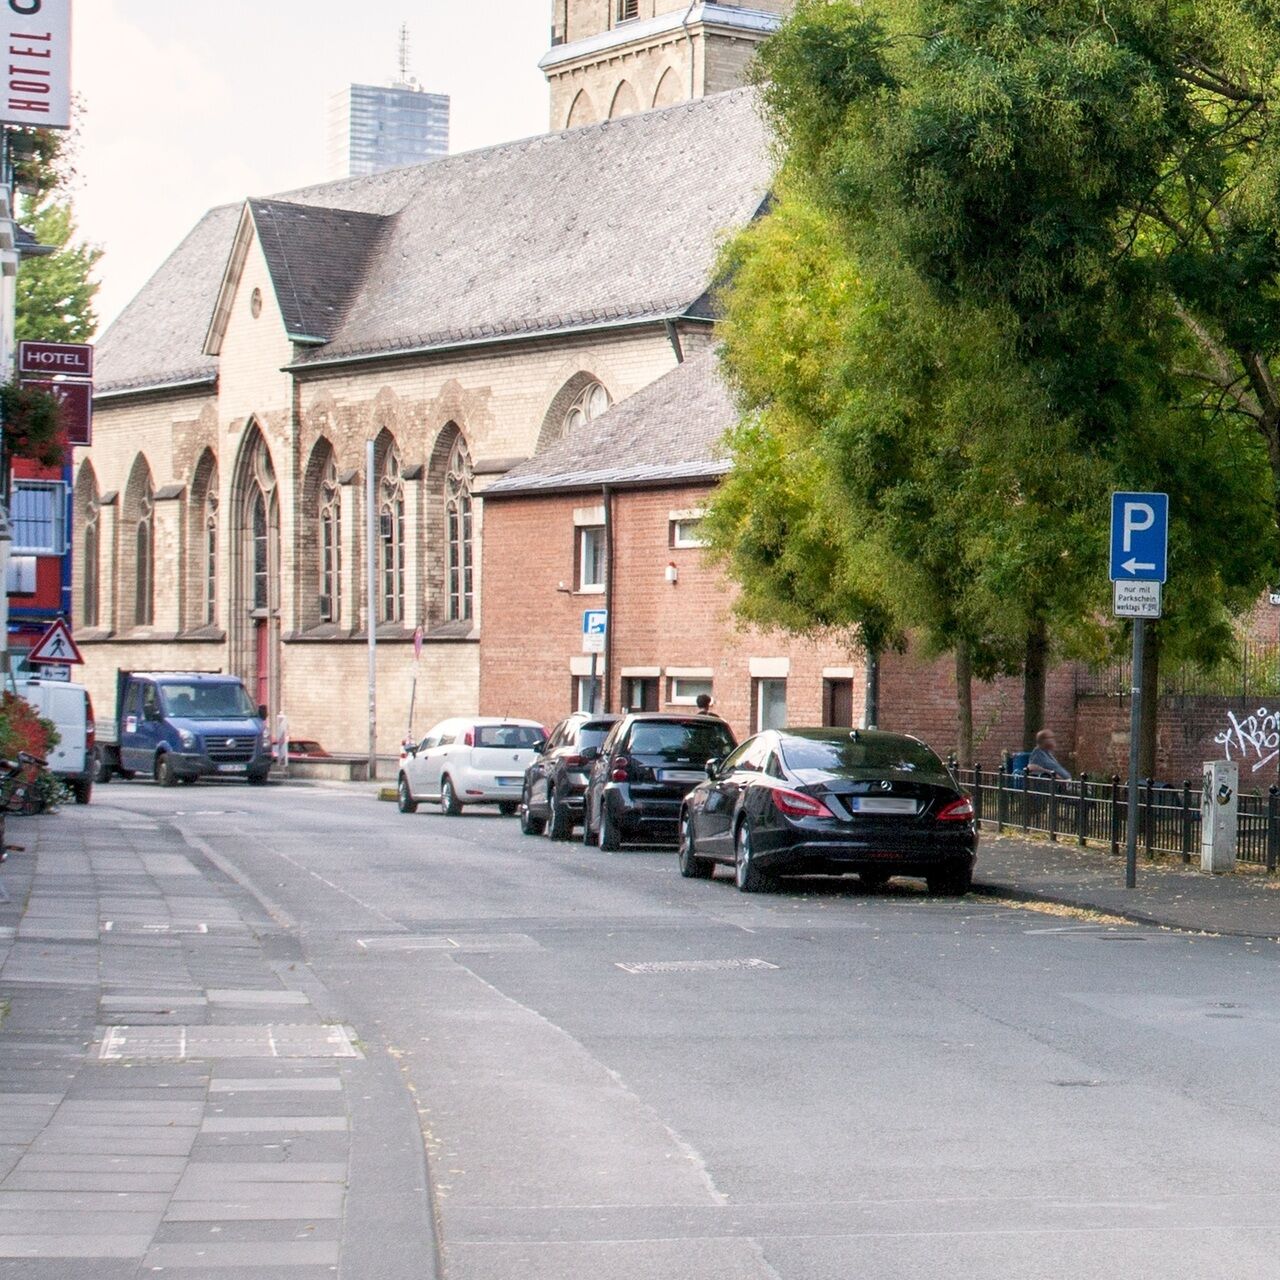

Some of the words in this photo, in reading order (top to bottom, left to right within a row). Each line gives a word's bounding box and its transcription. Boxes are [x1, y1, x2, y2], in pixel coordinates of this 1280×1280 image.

[8, 32, 51, 113] HOTEL
[27, 351, 85, 366] HOTEL
[1123, 502, 1155, 552] P
[1118, 594, 1157, 602] Parkschein
